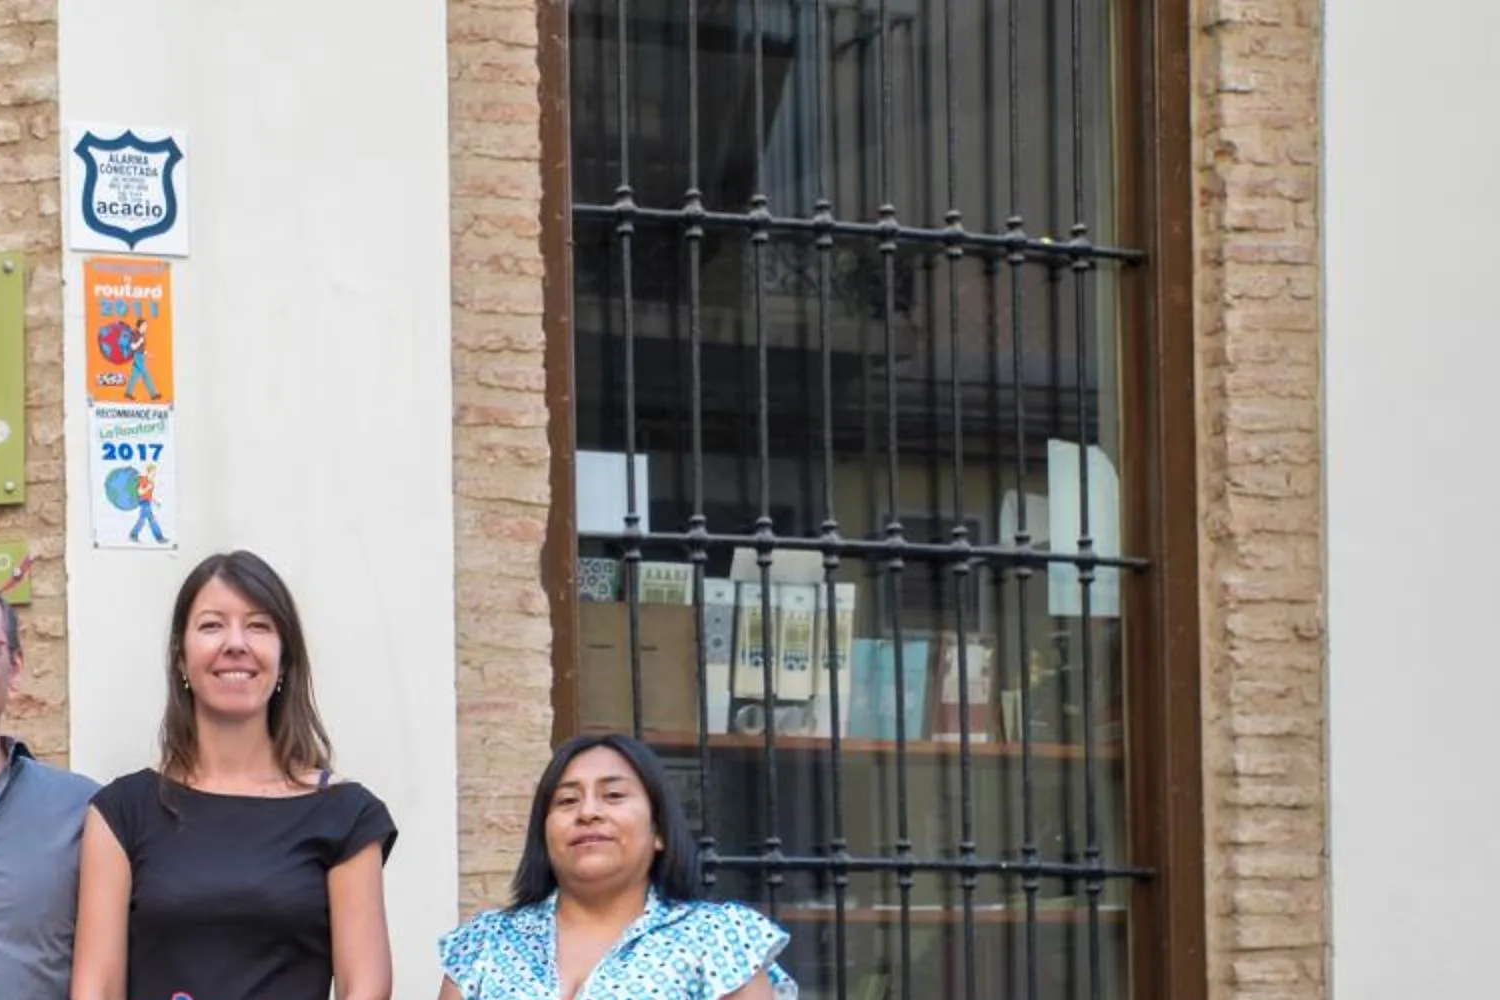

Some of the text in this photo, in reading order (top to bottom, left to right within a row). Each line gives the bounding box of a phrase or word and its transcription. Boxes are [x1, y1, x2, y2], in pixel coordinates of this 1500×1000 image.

[108, 153, 149, 165] ALARMA
[100, 164, 159, 177] CONECTADA
[96, 201, 162, 217] acacio
[102, 442, 164, 461] 2017
